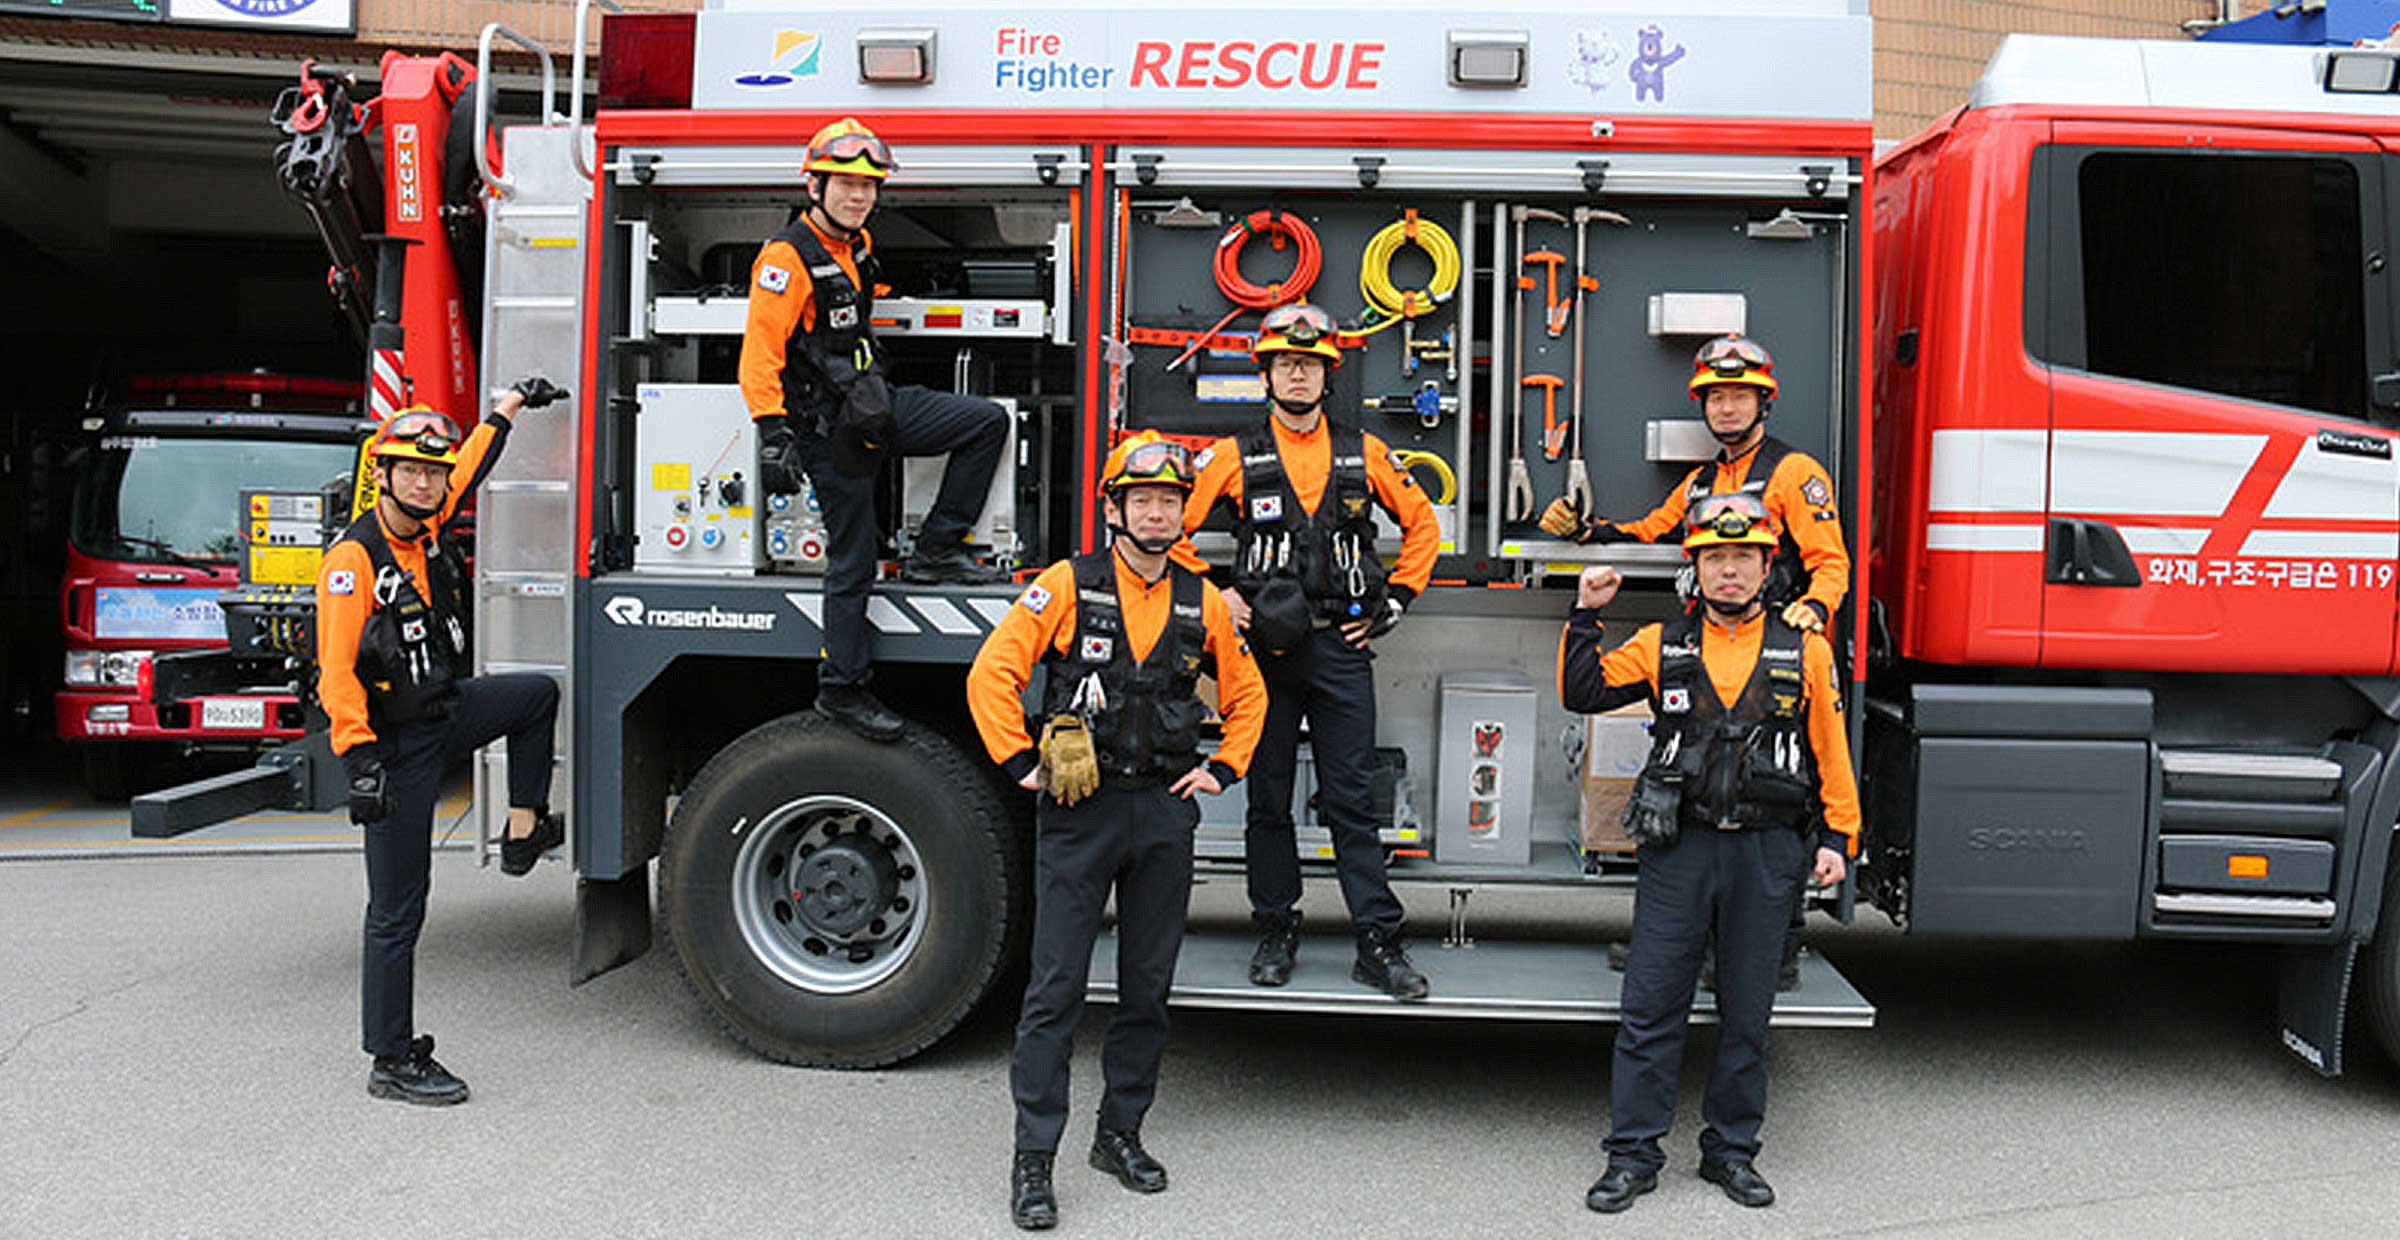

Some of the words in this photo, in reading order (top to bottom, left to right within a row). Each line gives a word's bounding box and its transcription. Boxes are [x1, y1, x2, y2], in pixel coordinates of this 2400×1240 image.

[997, 27, 1061, 55] Fire
[996, 60, 1115, 92] Fighter
[1129, 41, 1385, 89] RESCUE
[399, 149, 417, 217] KUHN
[2347, 564, 2393, 588] 119
[647, 605, 777, 631] rosenbauer
